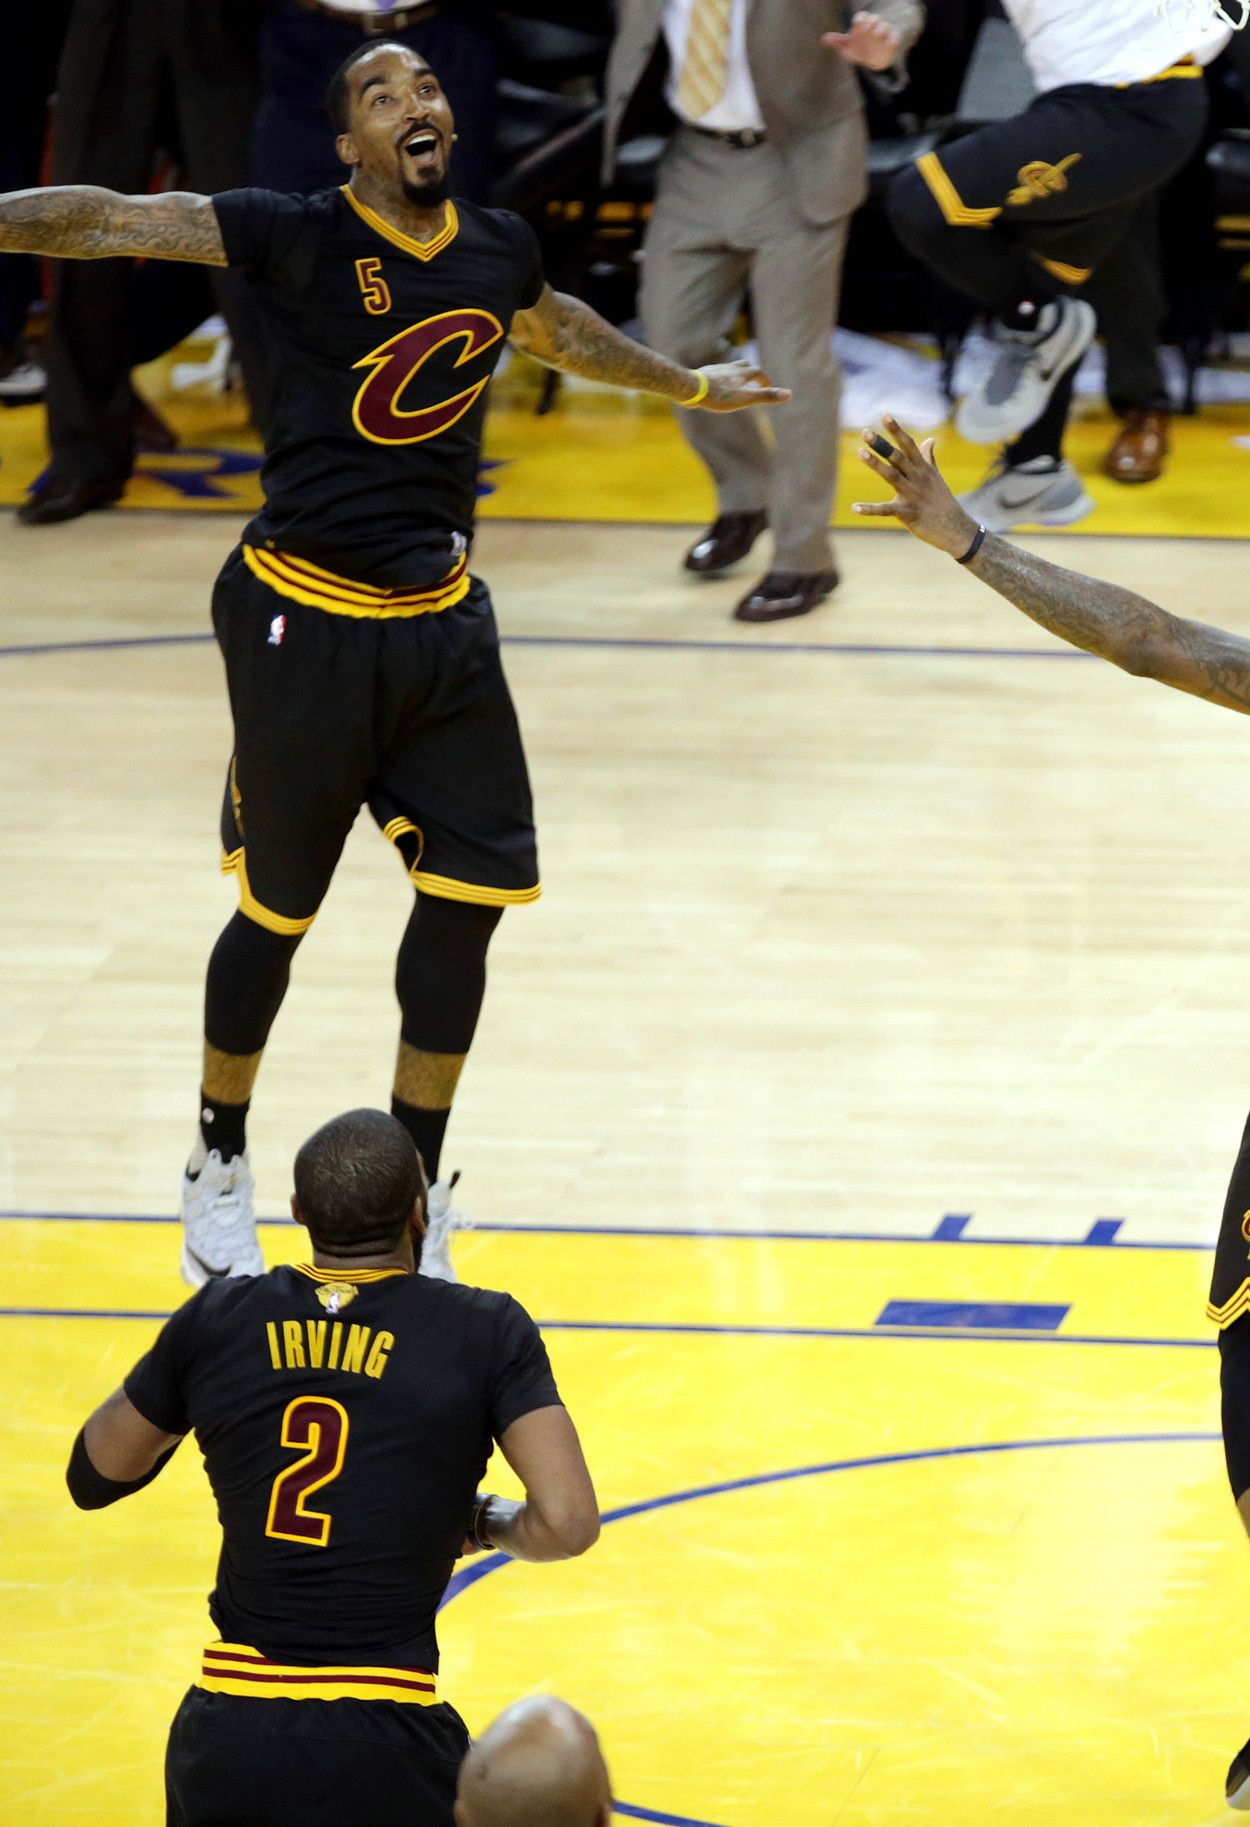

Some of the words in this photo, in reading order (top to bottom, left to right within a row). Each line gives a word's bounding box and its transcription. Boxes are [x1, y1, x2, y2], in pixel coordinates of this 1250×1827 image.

[355, 257, 392, 315] 5
[350, 308, 504, 445] C
[266, 1320, 395, 1379] IRVING
[265, 1395, 349, 1547] 2
